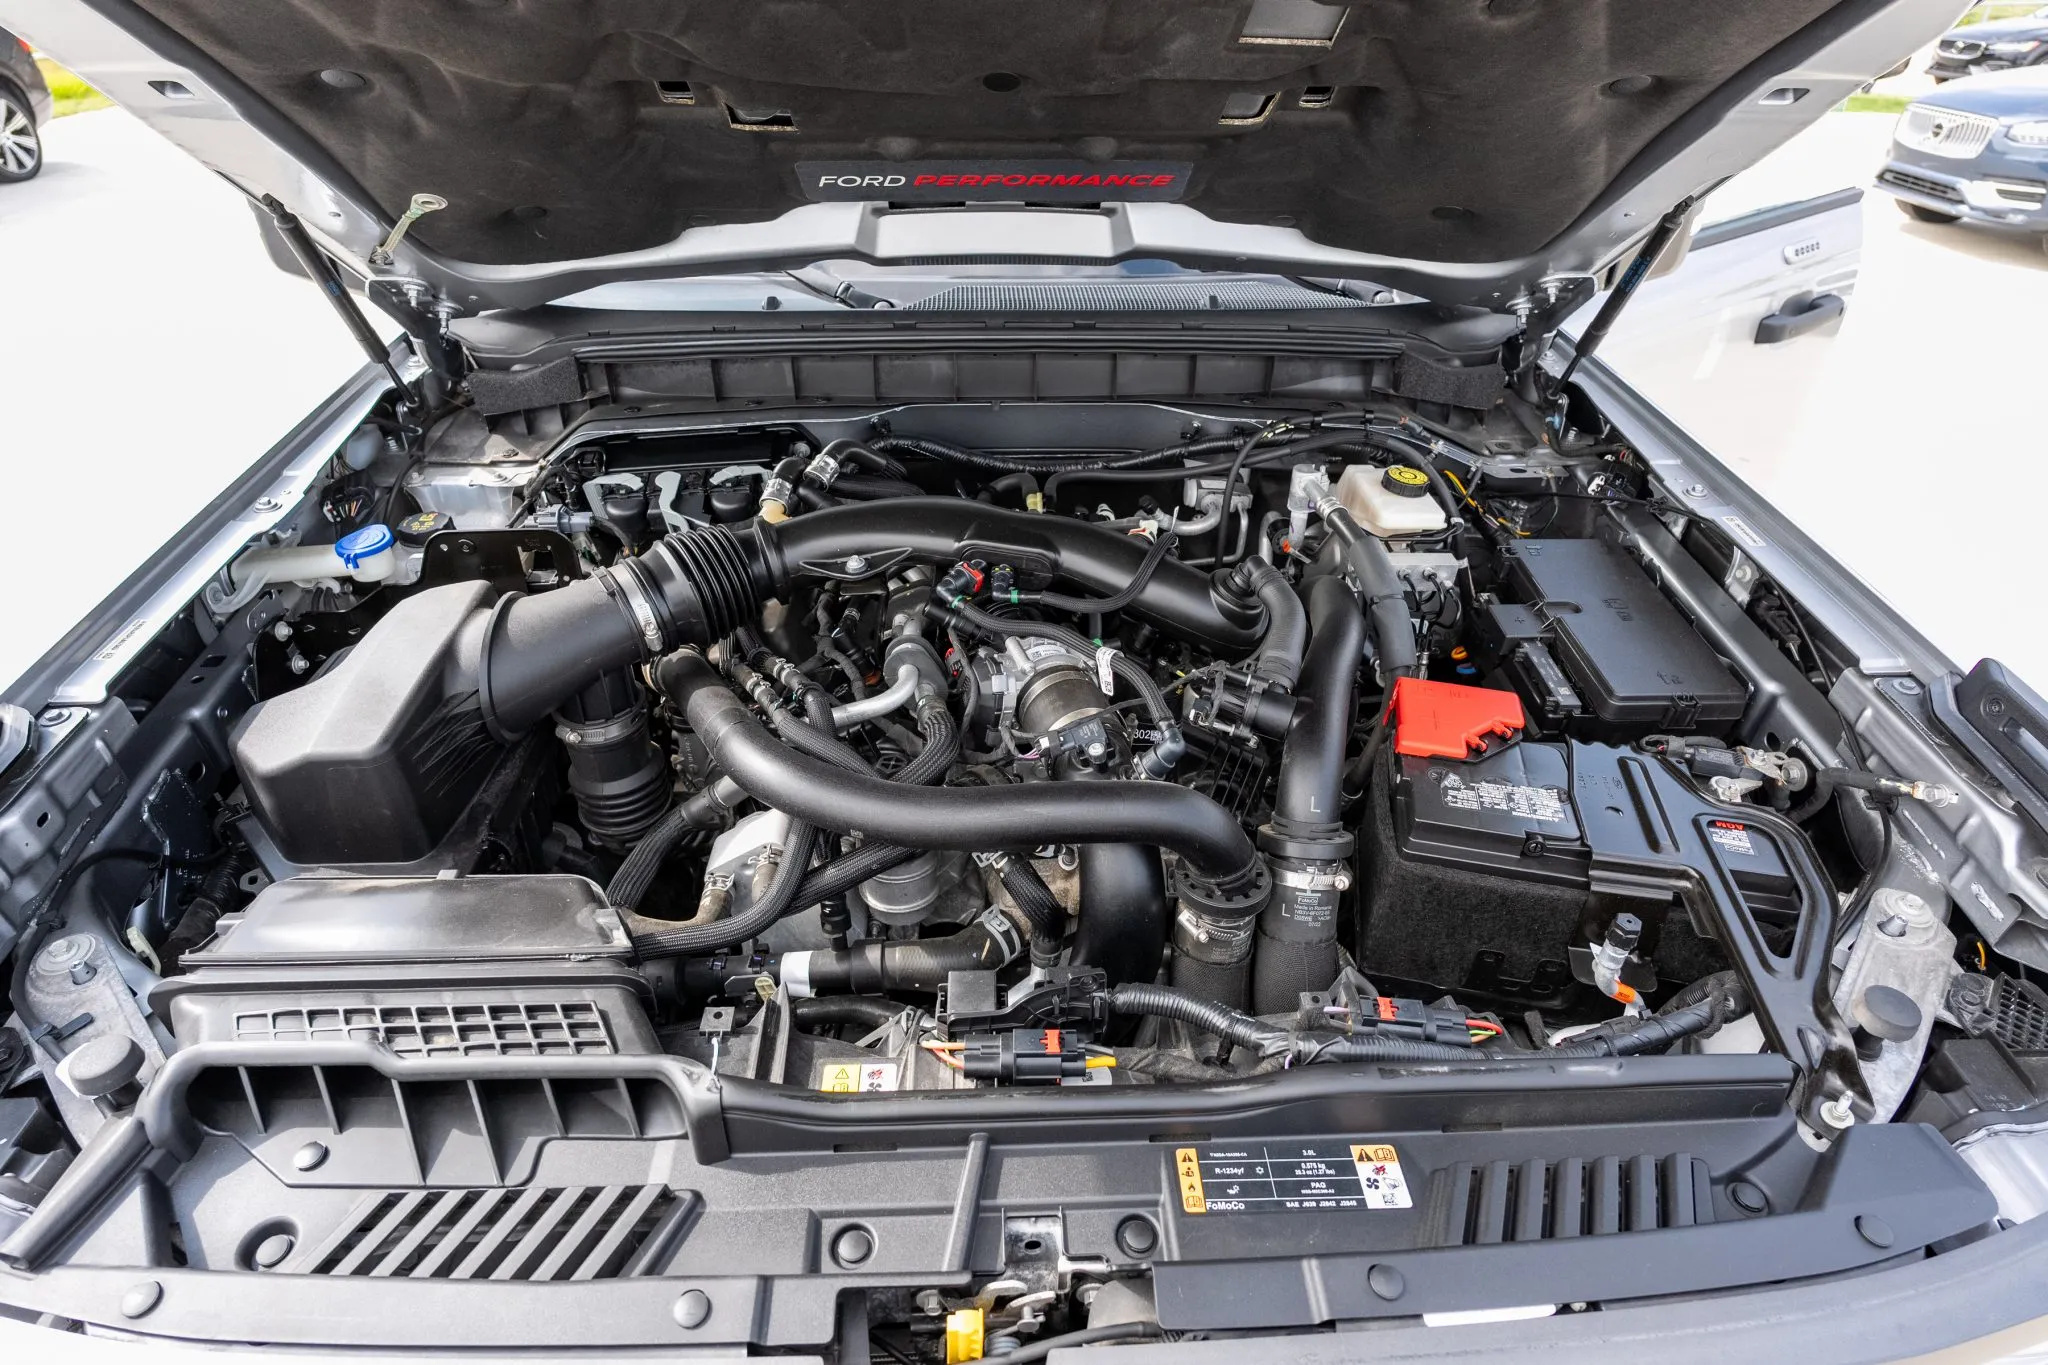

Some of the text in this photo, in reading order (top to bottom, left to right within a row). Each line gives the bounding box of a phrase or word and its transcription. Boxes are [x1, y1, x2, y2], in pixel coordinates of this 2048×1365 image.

[818, 174, 1176, 188] FORD PERFORMANCE
[1311, 796, 1320, 812] L
[1282, 903, 1291, 917] L
[1206, 1202, 1245, 1210] FoMoCo
